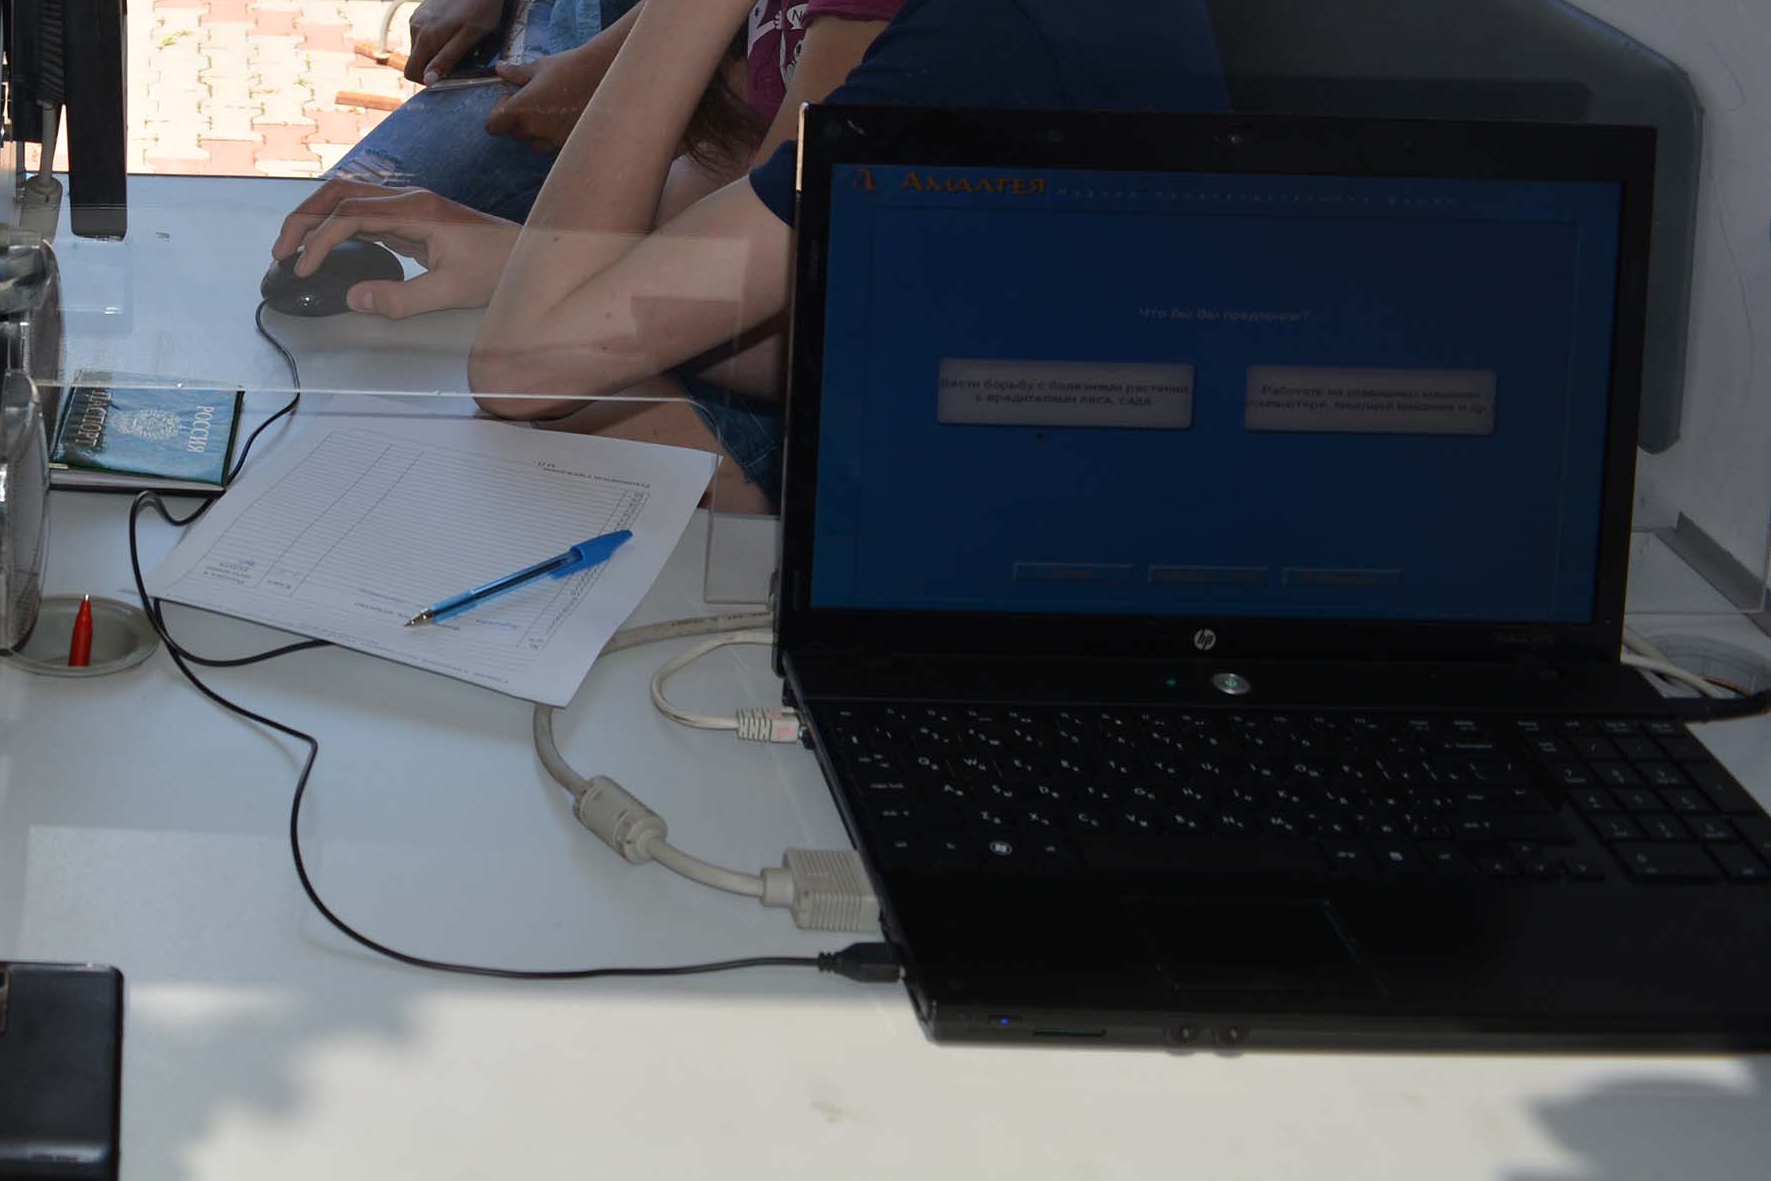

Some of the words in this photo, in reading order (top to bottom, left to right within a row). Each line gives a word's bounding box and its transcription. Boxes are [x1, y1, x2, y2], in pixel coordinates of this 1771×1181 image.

[75, 390, 113, 447] ПАСПОРТ
[187, 405, 215, 453] РОССИЯ
[1194, 628, 1216, 651] hp
